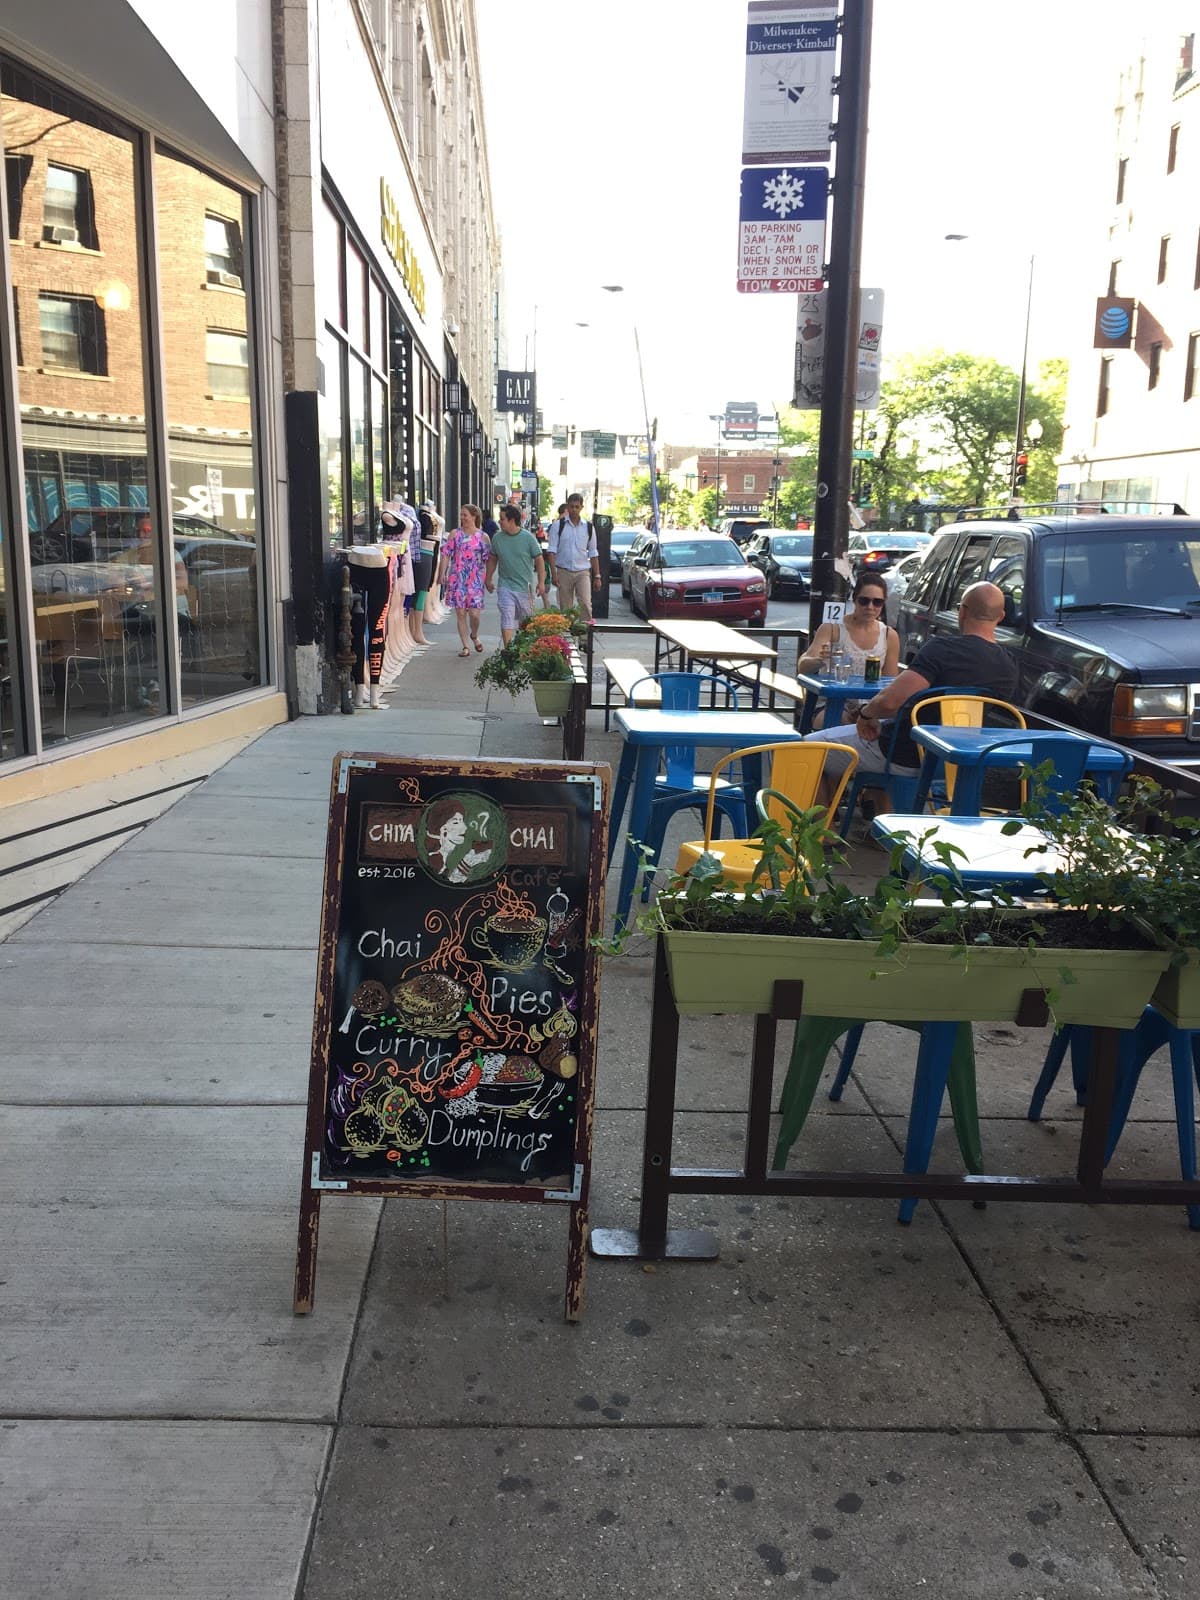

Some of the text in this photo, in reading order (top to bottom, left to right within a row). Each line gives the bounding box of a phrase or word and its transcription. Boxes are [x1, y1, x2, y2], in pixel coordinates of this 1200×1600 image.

[763, 25, 822, 37] Milwaukee-
[750, 37, 835, 51] Diversey-Kimball
[744, 223, 802, 233] NO PARKING
[743, 245, 762, 254] DEC
[806, 244, 819, 253] OR
[743, 255, 816, 265] WHEN SNOW IS
[742, 265, 818, 275] OVER 2 INCHES
[742, 279, 817, 291] TOW ZONE
[506, 378, 531, 399] GAP
[827, 605, 841, 620] 12
[370, 652, 382, 676] FIELD
[368, 823, 555, 850] CHIYA CHAI
[383, 866, 416, 879] 2016
[358, 928, 422, 959] Chai
[491, 976, 552, 1016] Pies
[355, 1025, 451, 1081] Curry
[427, 1109, 553, 1172] Dumplings
